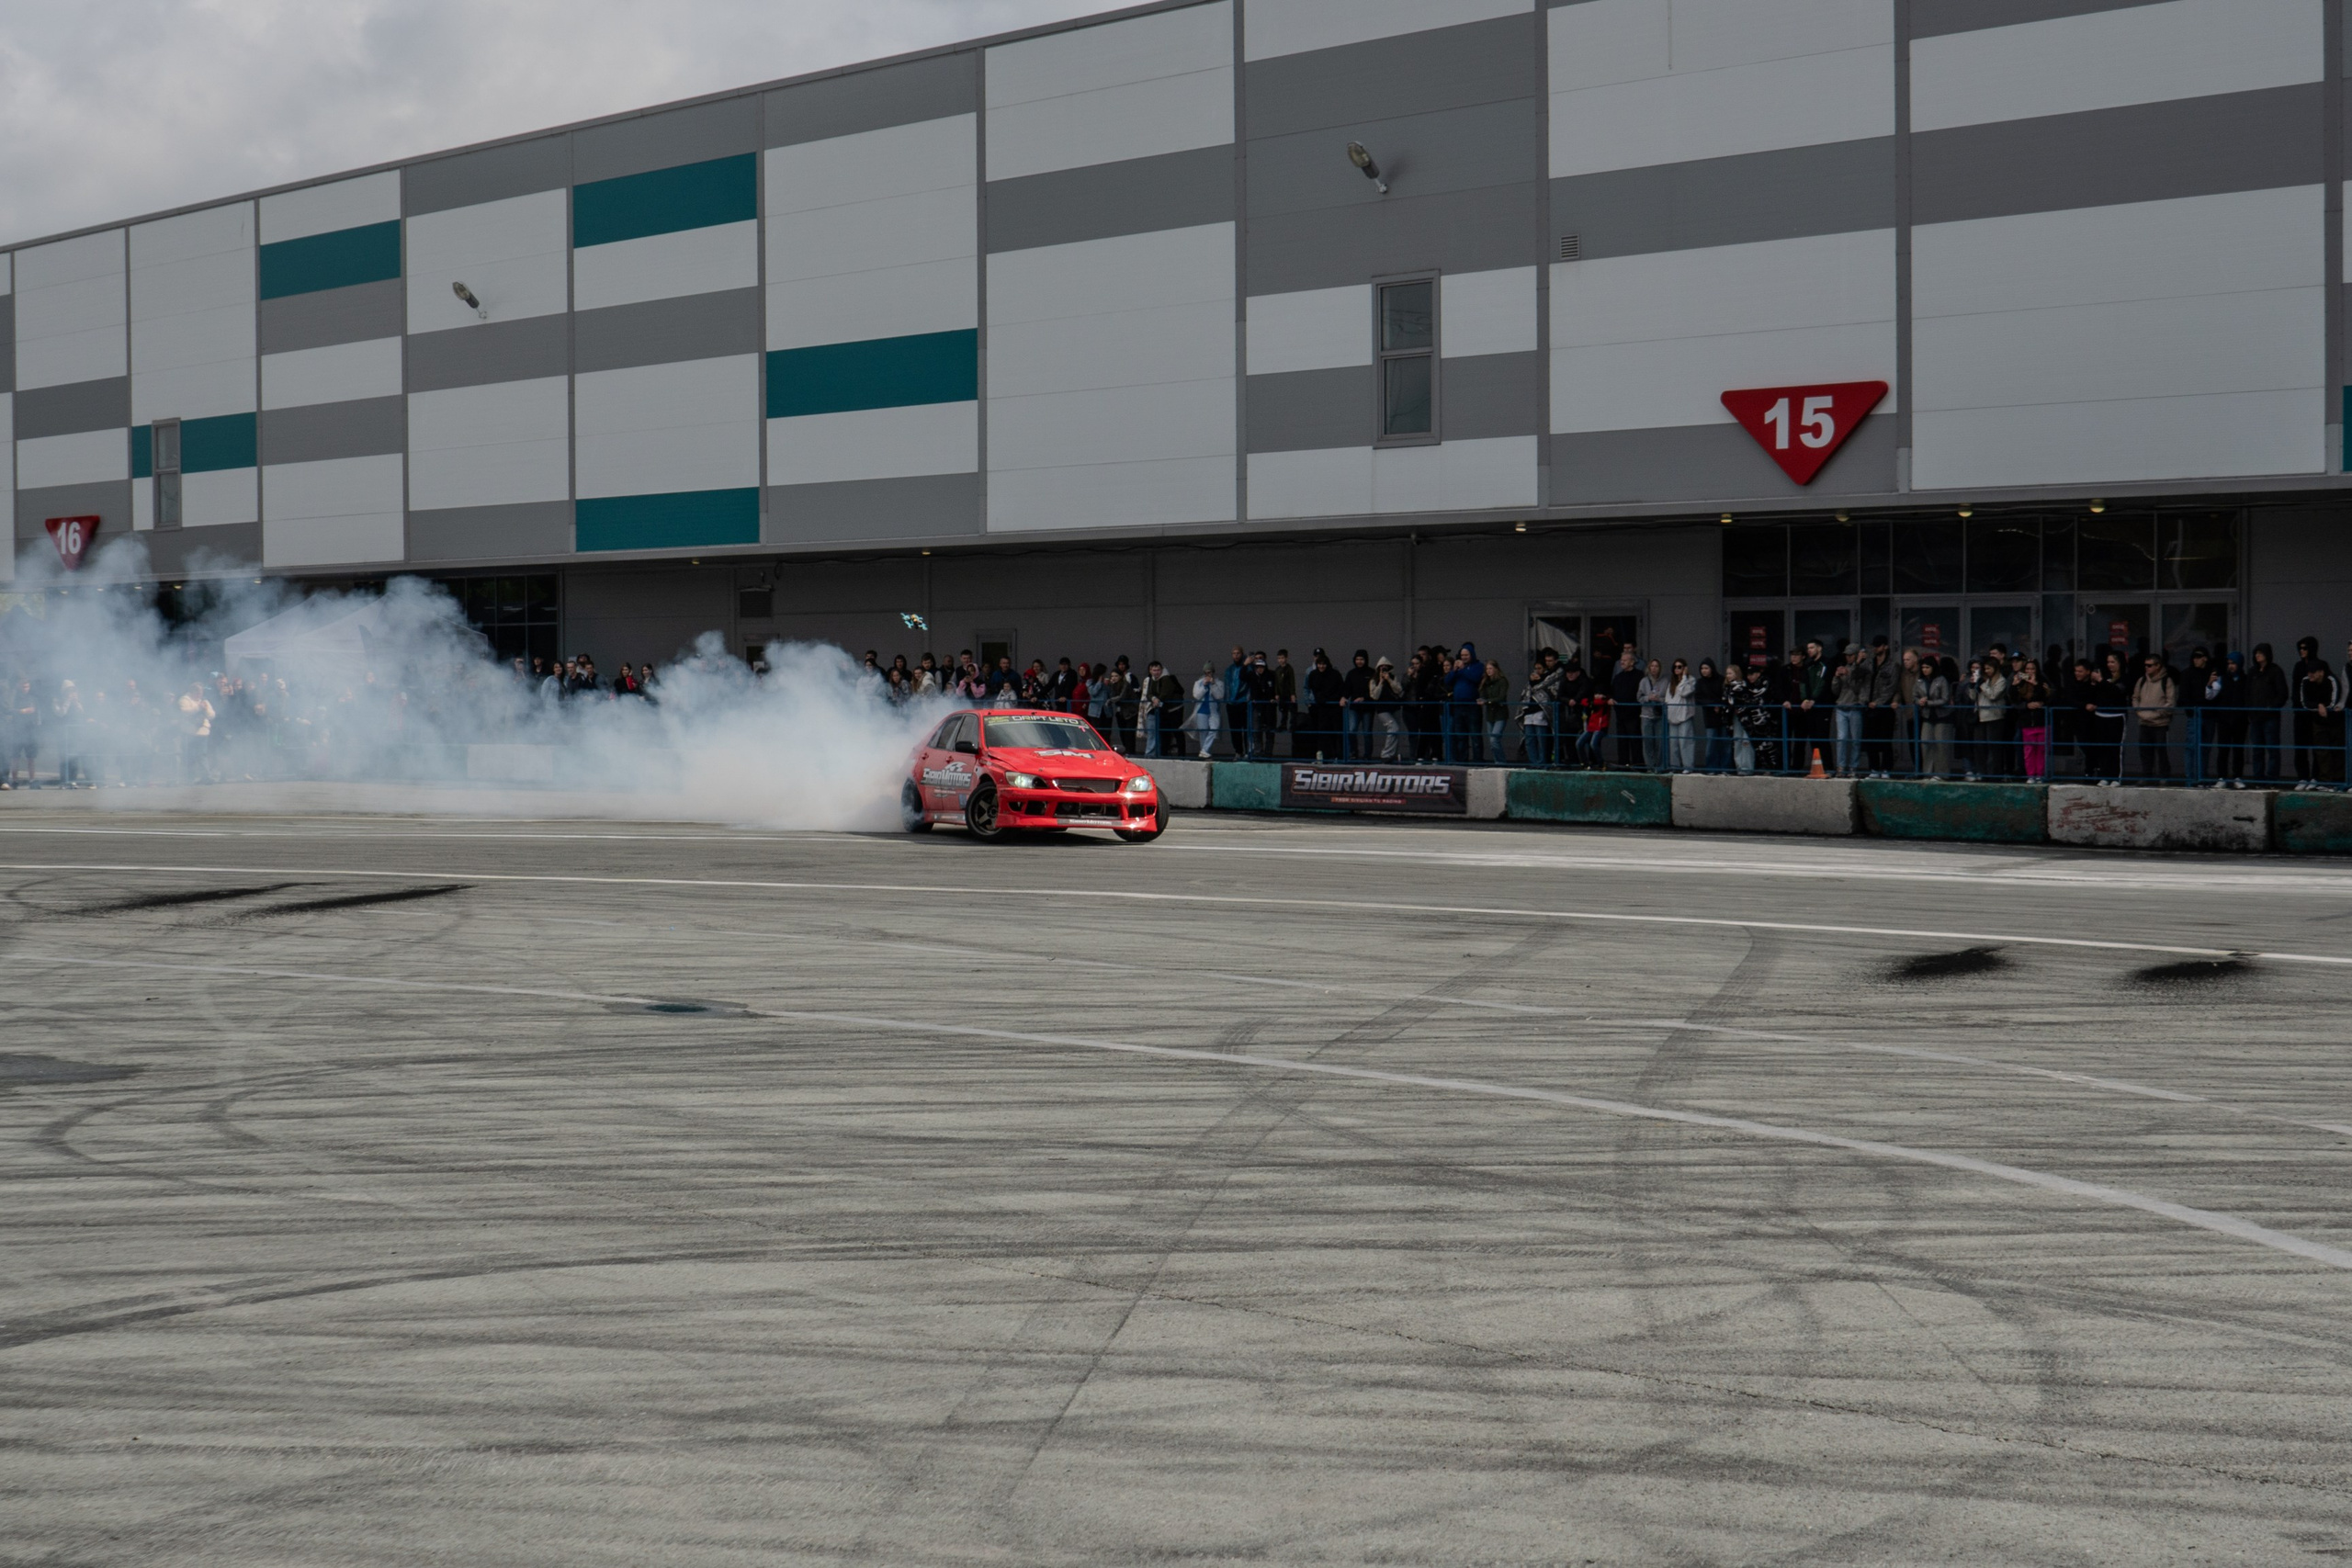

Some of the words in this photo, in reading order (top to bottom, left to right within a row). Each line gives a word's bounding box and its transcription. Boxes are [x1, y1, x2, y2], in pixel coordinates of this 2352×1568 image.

[1764, 395, 1835, 449] 15
[58, 521, 81, 555] 16
[1048, 716, 1079, 725] LETO
[1293, 769, 1451, 794] SIBIRMOTORS
